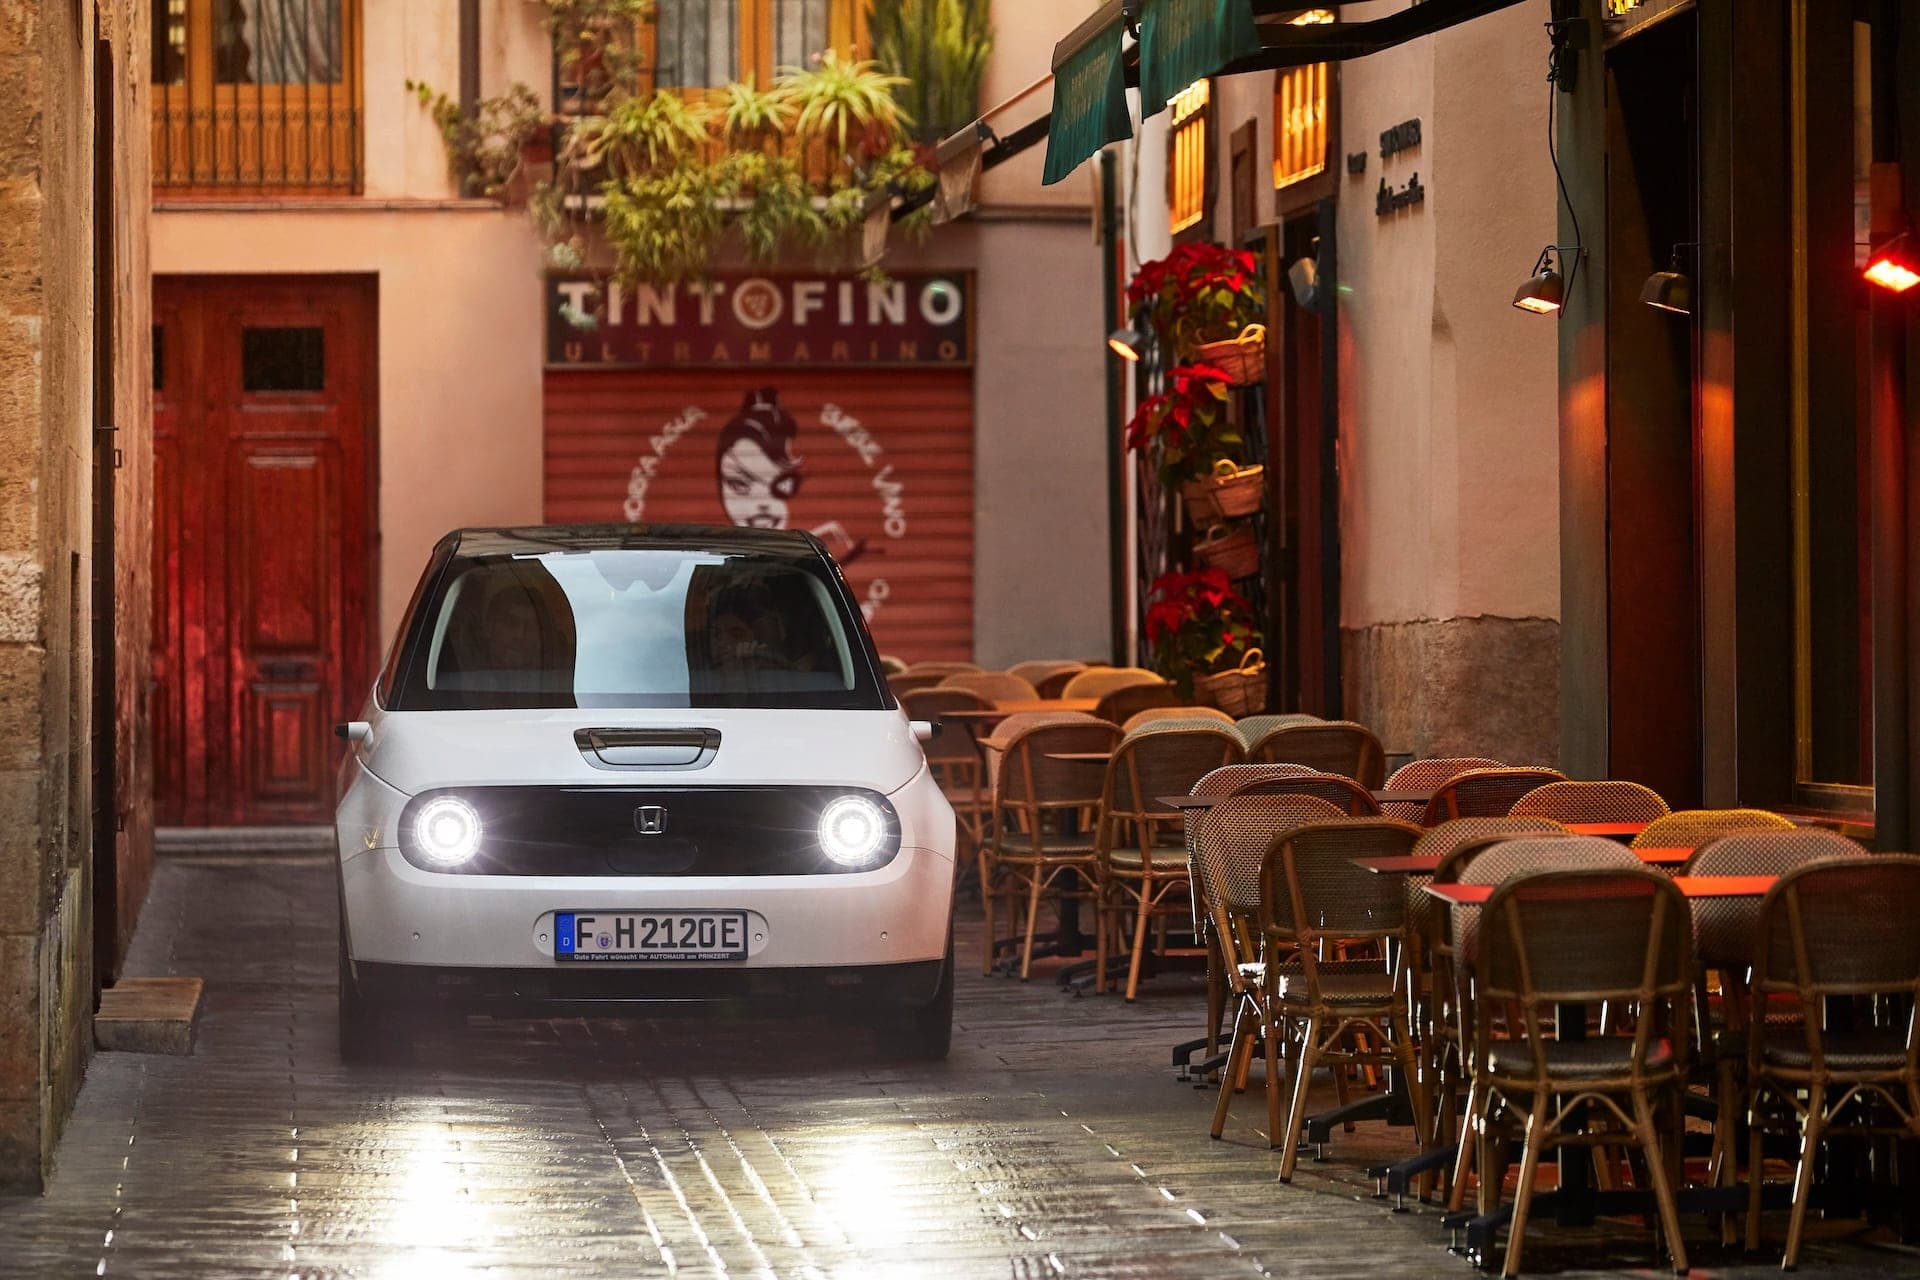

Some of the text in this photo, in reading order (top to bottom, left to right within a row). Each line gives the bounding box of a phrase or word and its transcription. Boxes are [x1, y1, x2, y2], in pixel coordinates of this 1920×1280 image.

[564, 340, 959, 362] ULTRAMARINO
[872, 463, 908, 537] VINO
[577, 917, 596, 948] F
[649, 952, 685, 960] AUTOHAUS
